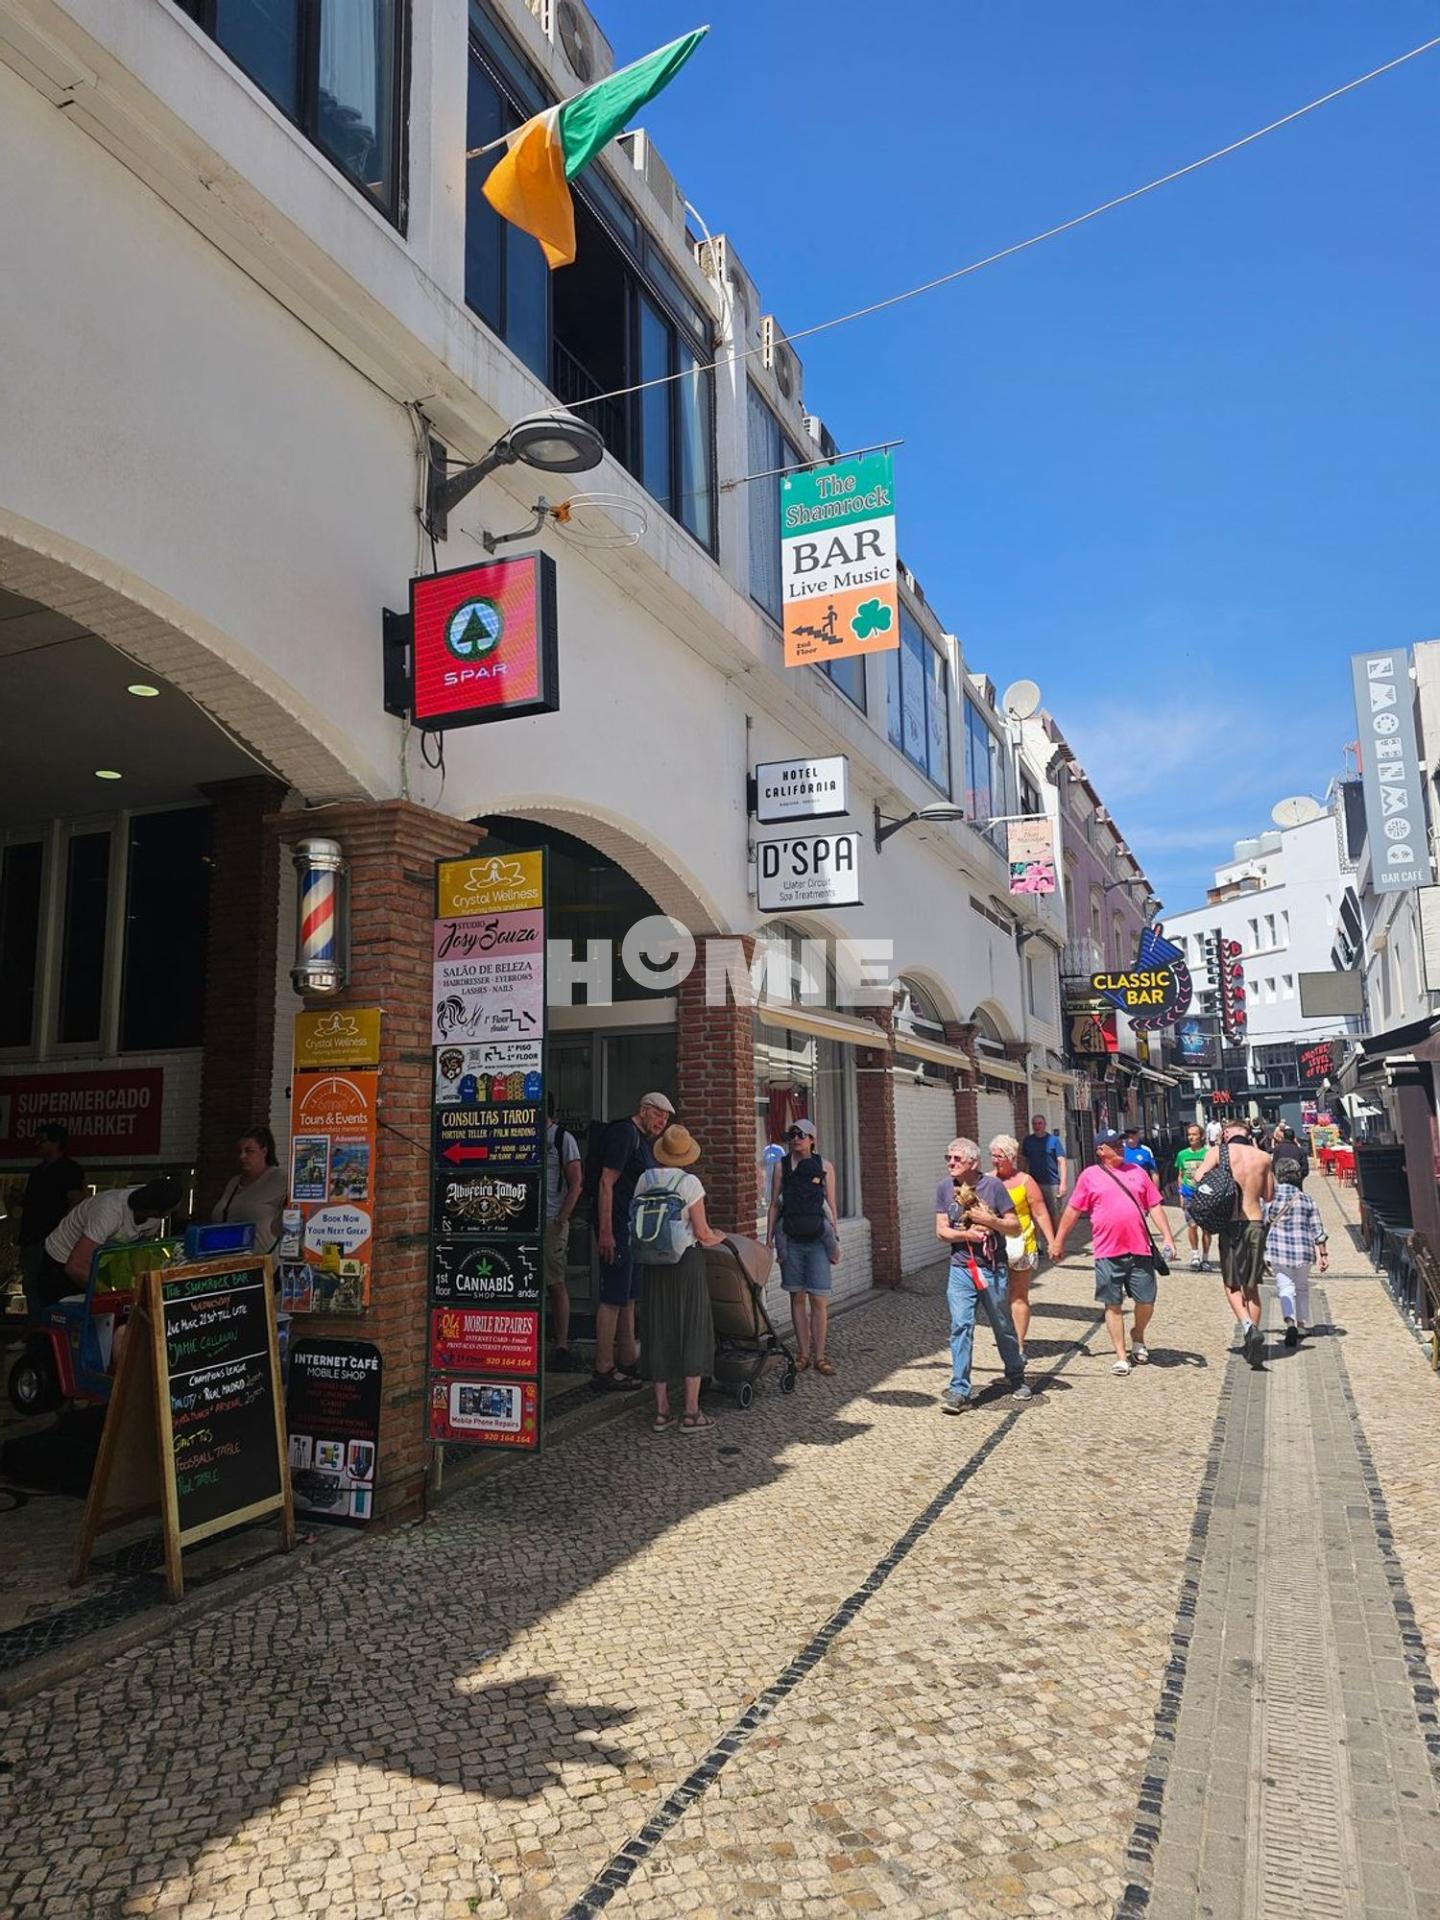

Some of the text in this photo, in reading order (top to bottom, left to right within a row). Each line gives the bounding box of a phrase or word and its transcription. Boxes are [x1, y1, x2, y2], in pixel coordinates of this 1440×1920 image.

[816, 473, 856, 498] The
[786, 485, 890, 528] Shamrock
[792, 528, 886, 575] BAR
[789, 566, 890, 598] Live Music
[444, 662, 509, 686] SPAR
[1366, 657, 1414, 865] DOWNTOWN
[782, 767, 818, 781] HOTEL
[763, 836, 853, 878] D'SPA
[783, 877, 831, 890] Water Circuit
[1381, 867, 1424, 884] BAR CAFÉ
[452, 891, 490, 908] Crystal
[492, 888, 539, 902] Wellness
[779, 889, 836, 902] Spa Treatments
[457, 920, 486, 930] STUDIO
[479, 919, 540, 951] Souza
[442, 961, 532, 978] SALÃO DE BELEZA
[442, 977, 490, 987] HAIRDRESSER
[492, 985, 514, 993] NAILS
[1093, 971, 1170, 990] CLASSIC
[1127, 988, 1164, 1005] BAR
[305, 1037, 368, 1050] Crystal Wellness
[18, 1086, 151, 1113] SUPERMERCADO
[16, 1113, 137, 1138] SUMARKET
[299, 1111, 368, 1126] Tours & Events
[442, 1108, 536, 1127] CONSULTAS TAROT
[166, 1283, 181, 1299] THE
[231, 1272, 250, 1285] BAR
[436, 1273, 448, 1285] 1st
[456, 1274, 514, 1292] CANNABIS
[435, 1285, 451, 1295] floor
[463, 1315, 494, 1333] MOBILE
[294, 1353, 379, 1370] INTERNET CAFÉ
[500, 1357, 515, 1366] 164
[306, 1367, 366, 1381] MOBILE SHOP
[452, 1416, 519, 1429] Mobile Phone Repairs
